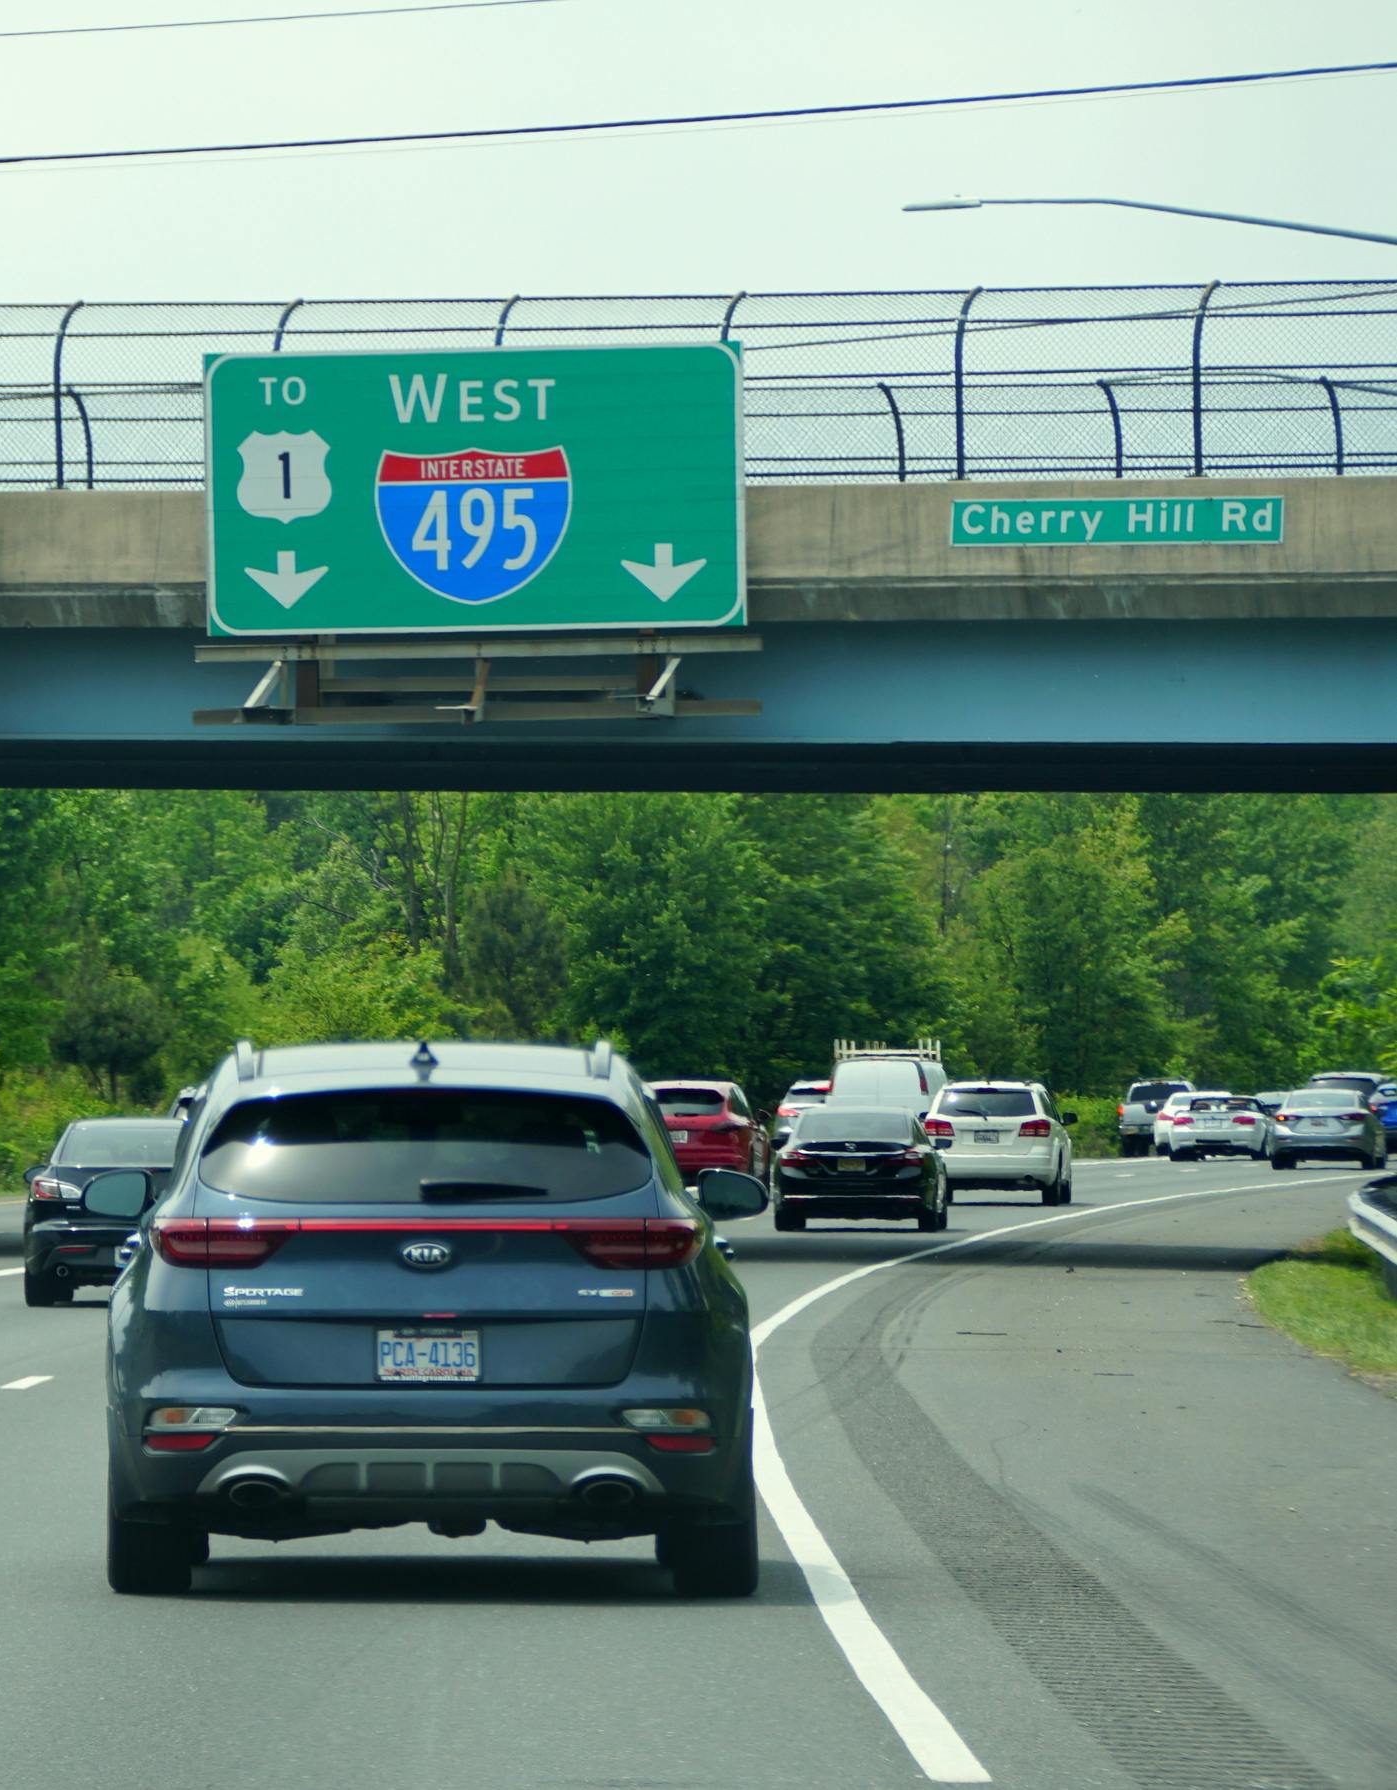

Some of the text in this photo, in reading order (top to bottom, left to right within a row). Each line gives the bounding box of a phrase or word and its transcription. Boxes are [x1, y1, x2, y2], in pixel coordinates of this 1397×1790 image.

[258, 376, 307, 406] TO
[388, 373, 556, 424] WEST
[278, 451, 291, 500] 1
[420, 458, 526, 479] INTERSTATE
[411, 487, 537, 571] 495
[961, 501, 1273, 540] Cherry Hill Rd
[411, 1247, 443, 1262] KIA
[379, 1341, 477, 1367] PCA-4136
